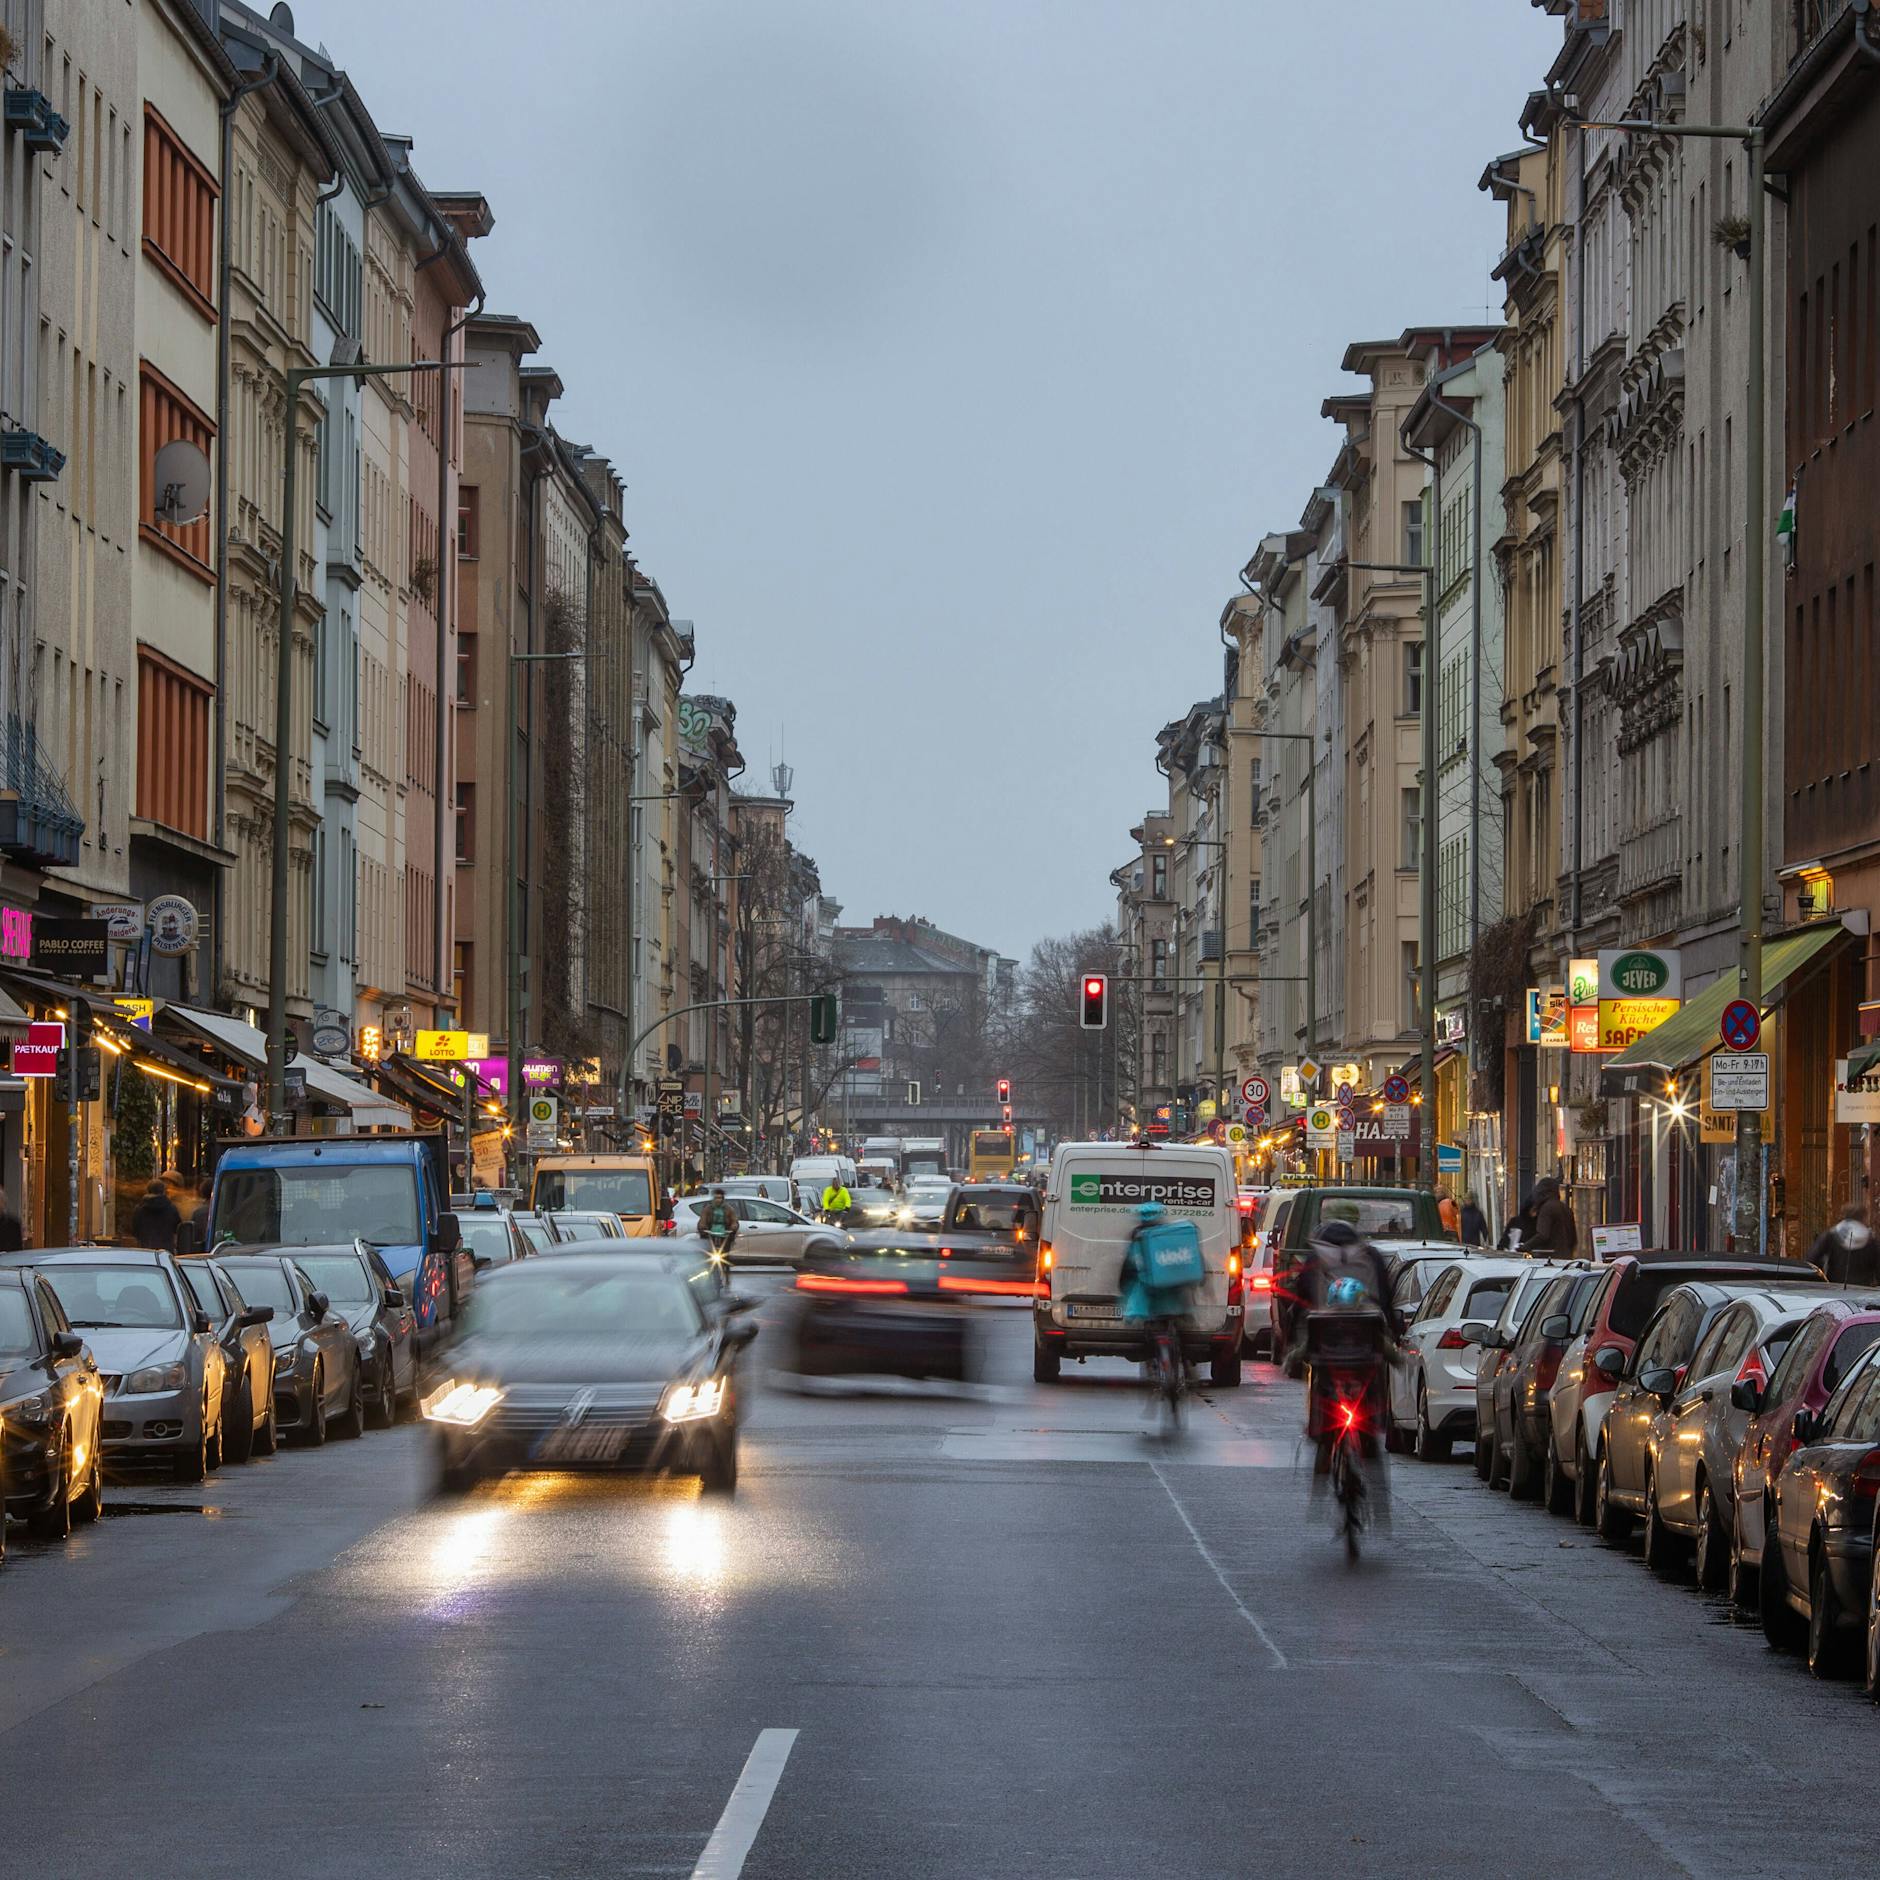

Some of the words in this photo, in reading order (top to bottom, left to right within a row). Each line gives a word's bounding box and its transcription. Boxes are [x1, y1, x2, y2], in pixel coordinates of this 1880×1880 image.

[148, 900, 193, 922] FLENSBURGER
[39, 939, 69, 949] PABLO
[71, 939, 105, 949] COFFEE
[153, 935, 188, 951] PILSENER
[1622, 970, 1658, 989] JEVER
[1612, 1002, 1668, 1013] Persische
[1619, 1013, 1657, 1025] Küche
[429, 1049, 456, 1057] LOTTO
[1715, 1059, 1740, 1070] Mo-Fr
[1247, 1084, 1264, 1097] 30
[1079, 1181, 1213, 1201] enterprise
[1163, 1197, 1212, 1206] rent-a-car
[1070, 1206, 1131, 1215] enterprise.de
[1171, 1208, 1215, 1217] 3722826
